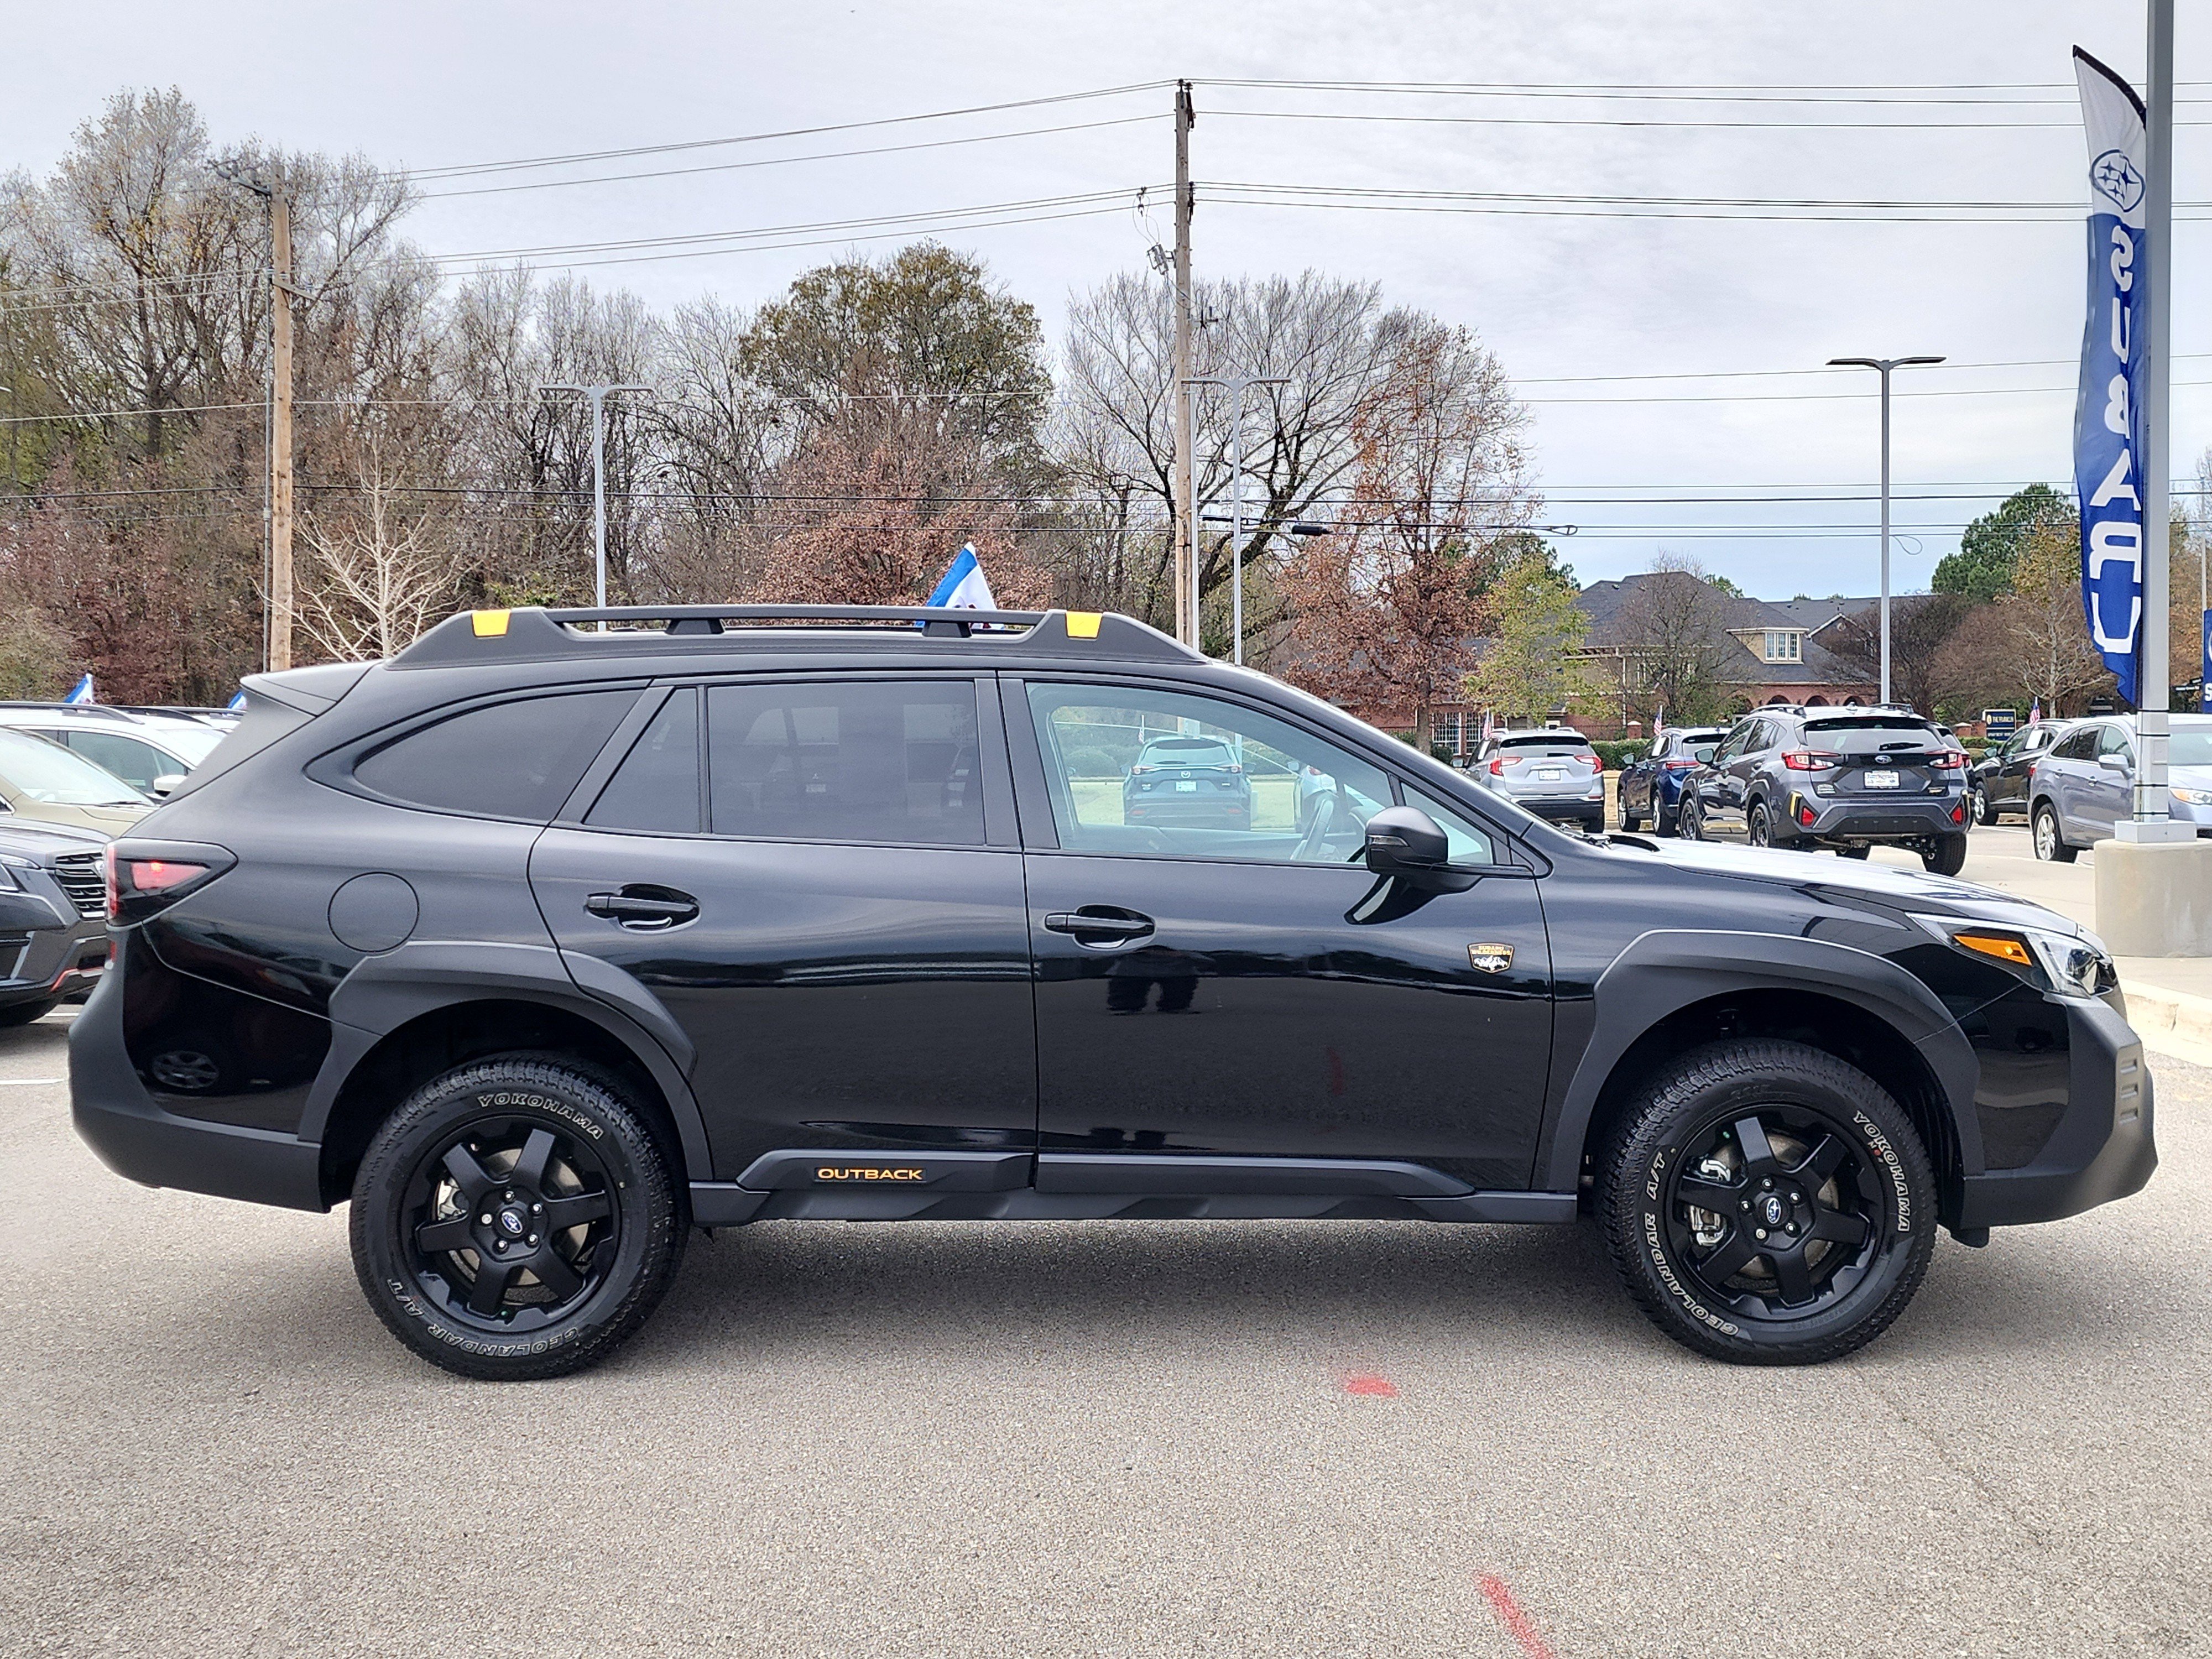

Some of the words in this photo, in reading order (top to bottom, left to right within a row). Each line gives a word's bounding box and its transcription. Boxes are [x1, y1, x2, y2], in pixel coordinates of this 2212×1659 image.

[477, 1092, 604, 1140] YOKOHAMA
[818, 1168, 923, 1180] OUTBACK
[1645, 1151, 1666, 1201] A/T
[1853, 1109, 1911, 1232] YOKOHAMA
[387, 1277, 425, 1317] A/T
[1644, 1212, 1740, 1337] GEOLANDAR
[427, 1322, 580, 1357] GEOLANDAR
